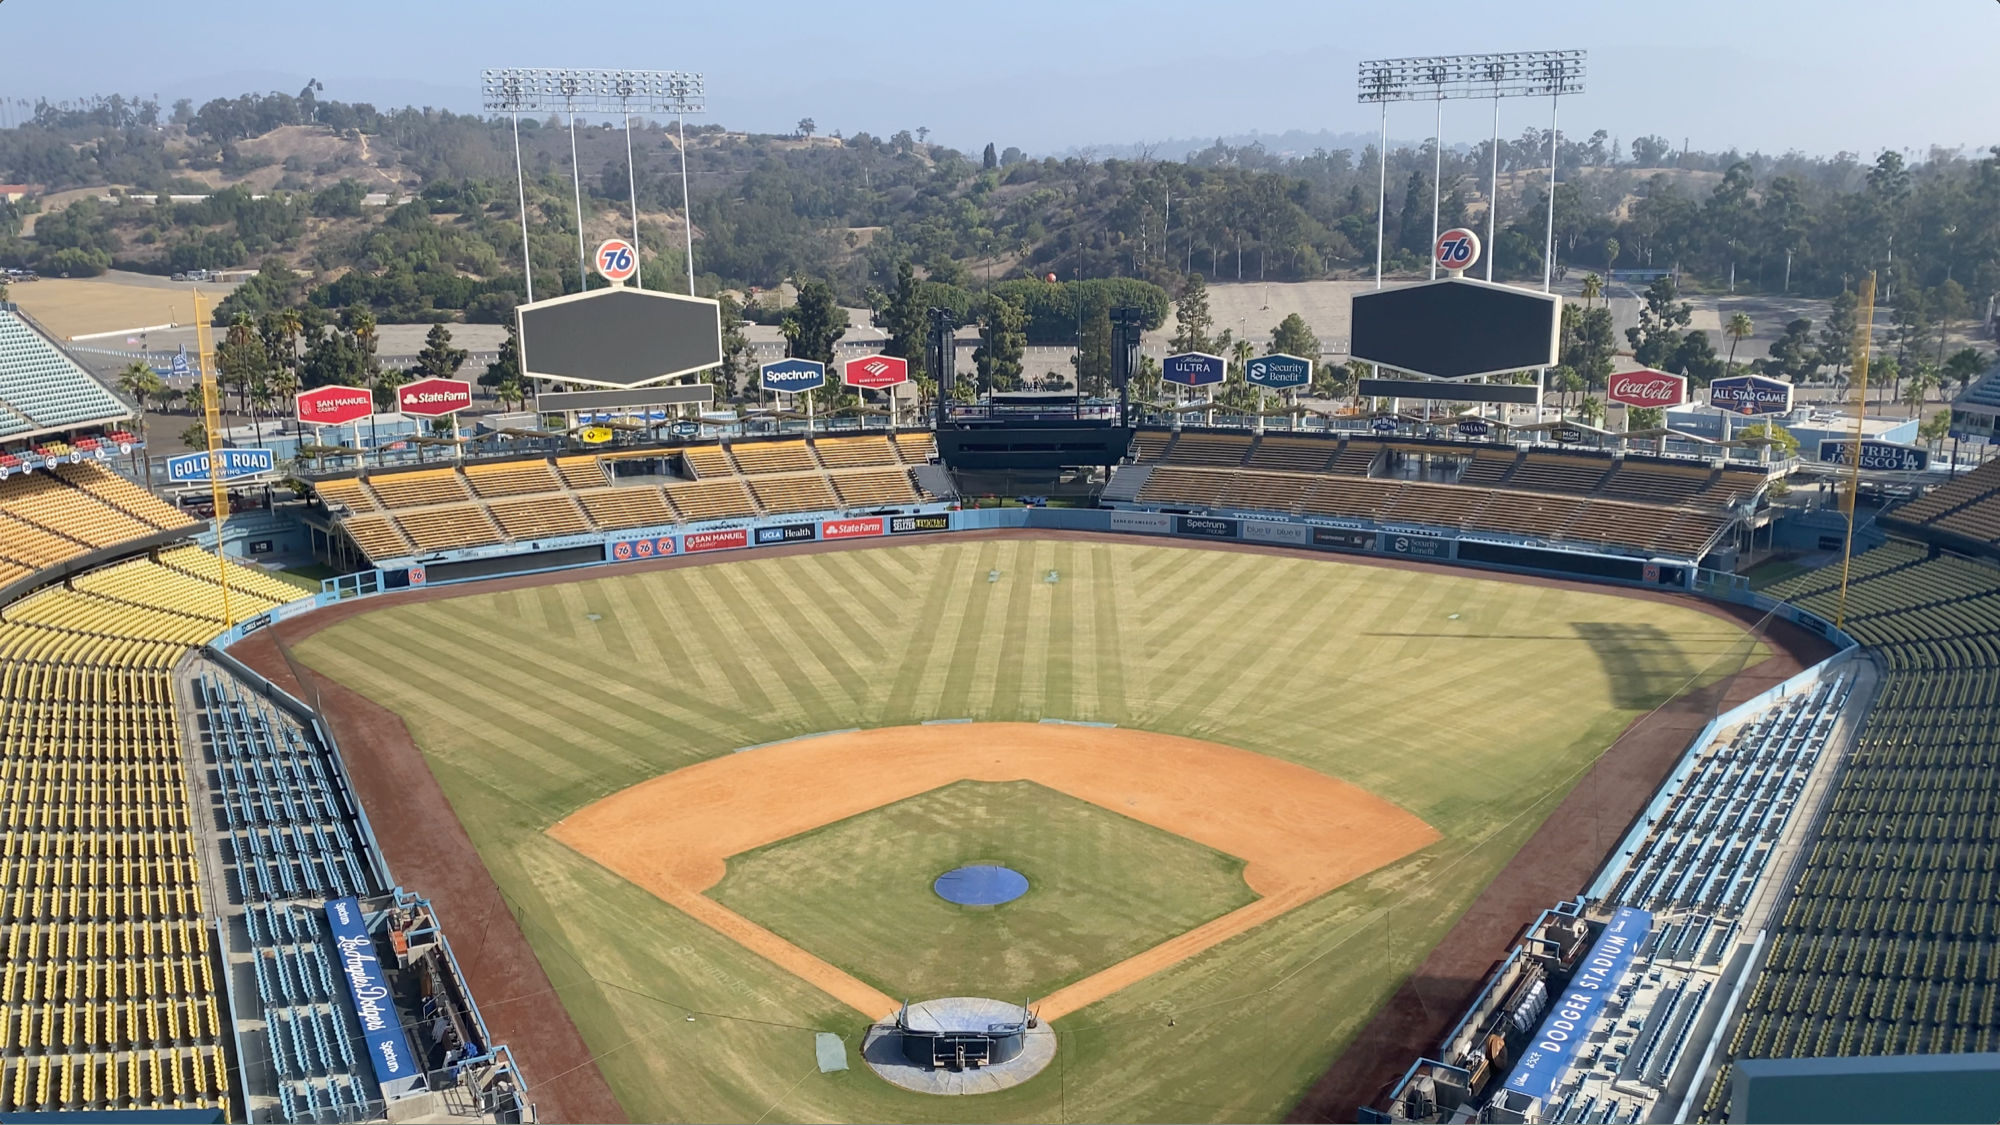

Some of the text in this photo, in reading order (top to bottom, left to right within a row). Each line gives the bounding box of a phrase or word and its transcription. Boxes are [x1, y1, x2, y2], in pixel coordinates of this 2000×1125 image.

[1440, 237, 1471, 262] 76
[602, 247, 631, 272] 76
[1175, 363, 1211, 372] ULTRA
[1269, 363, 1303, 373] Security
[766, 370, 816, 383] Spectrum
[1269, 372, 1299, 381] Benefit
[1613, 377, 1676, 400] Coca-Cola
[335, 398, 368, 406] MANUEL
[1713, 389, 1786, 403] ALL STAR GAME
[1460, 424, 1487, 433] DASANI
[232, 453, 268, 468] ROAD
[205, 469, 241, 478] BEWING
[1186, 519, 1225, 530] Spectrum
[712, 532, 744, 541] MANUEL
[784, 527, 811, 538] Health
[618, 541, 671, 555] 76 76 76
[1410, 539, 1438, 548] Security
[1410, 546, 1434, 555] Benefit
[412, 572, 422, 580] 76
[334, 902, 350, 926] Spectrum
[345, 950, 376, 992] Angeles
[1540, 935, 1628, 1052] DODGER STADIUM
[356, 986, 388, 1031] Dodgers
[379, 1040, 399, 1073] Spectrum
